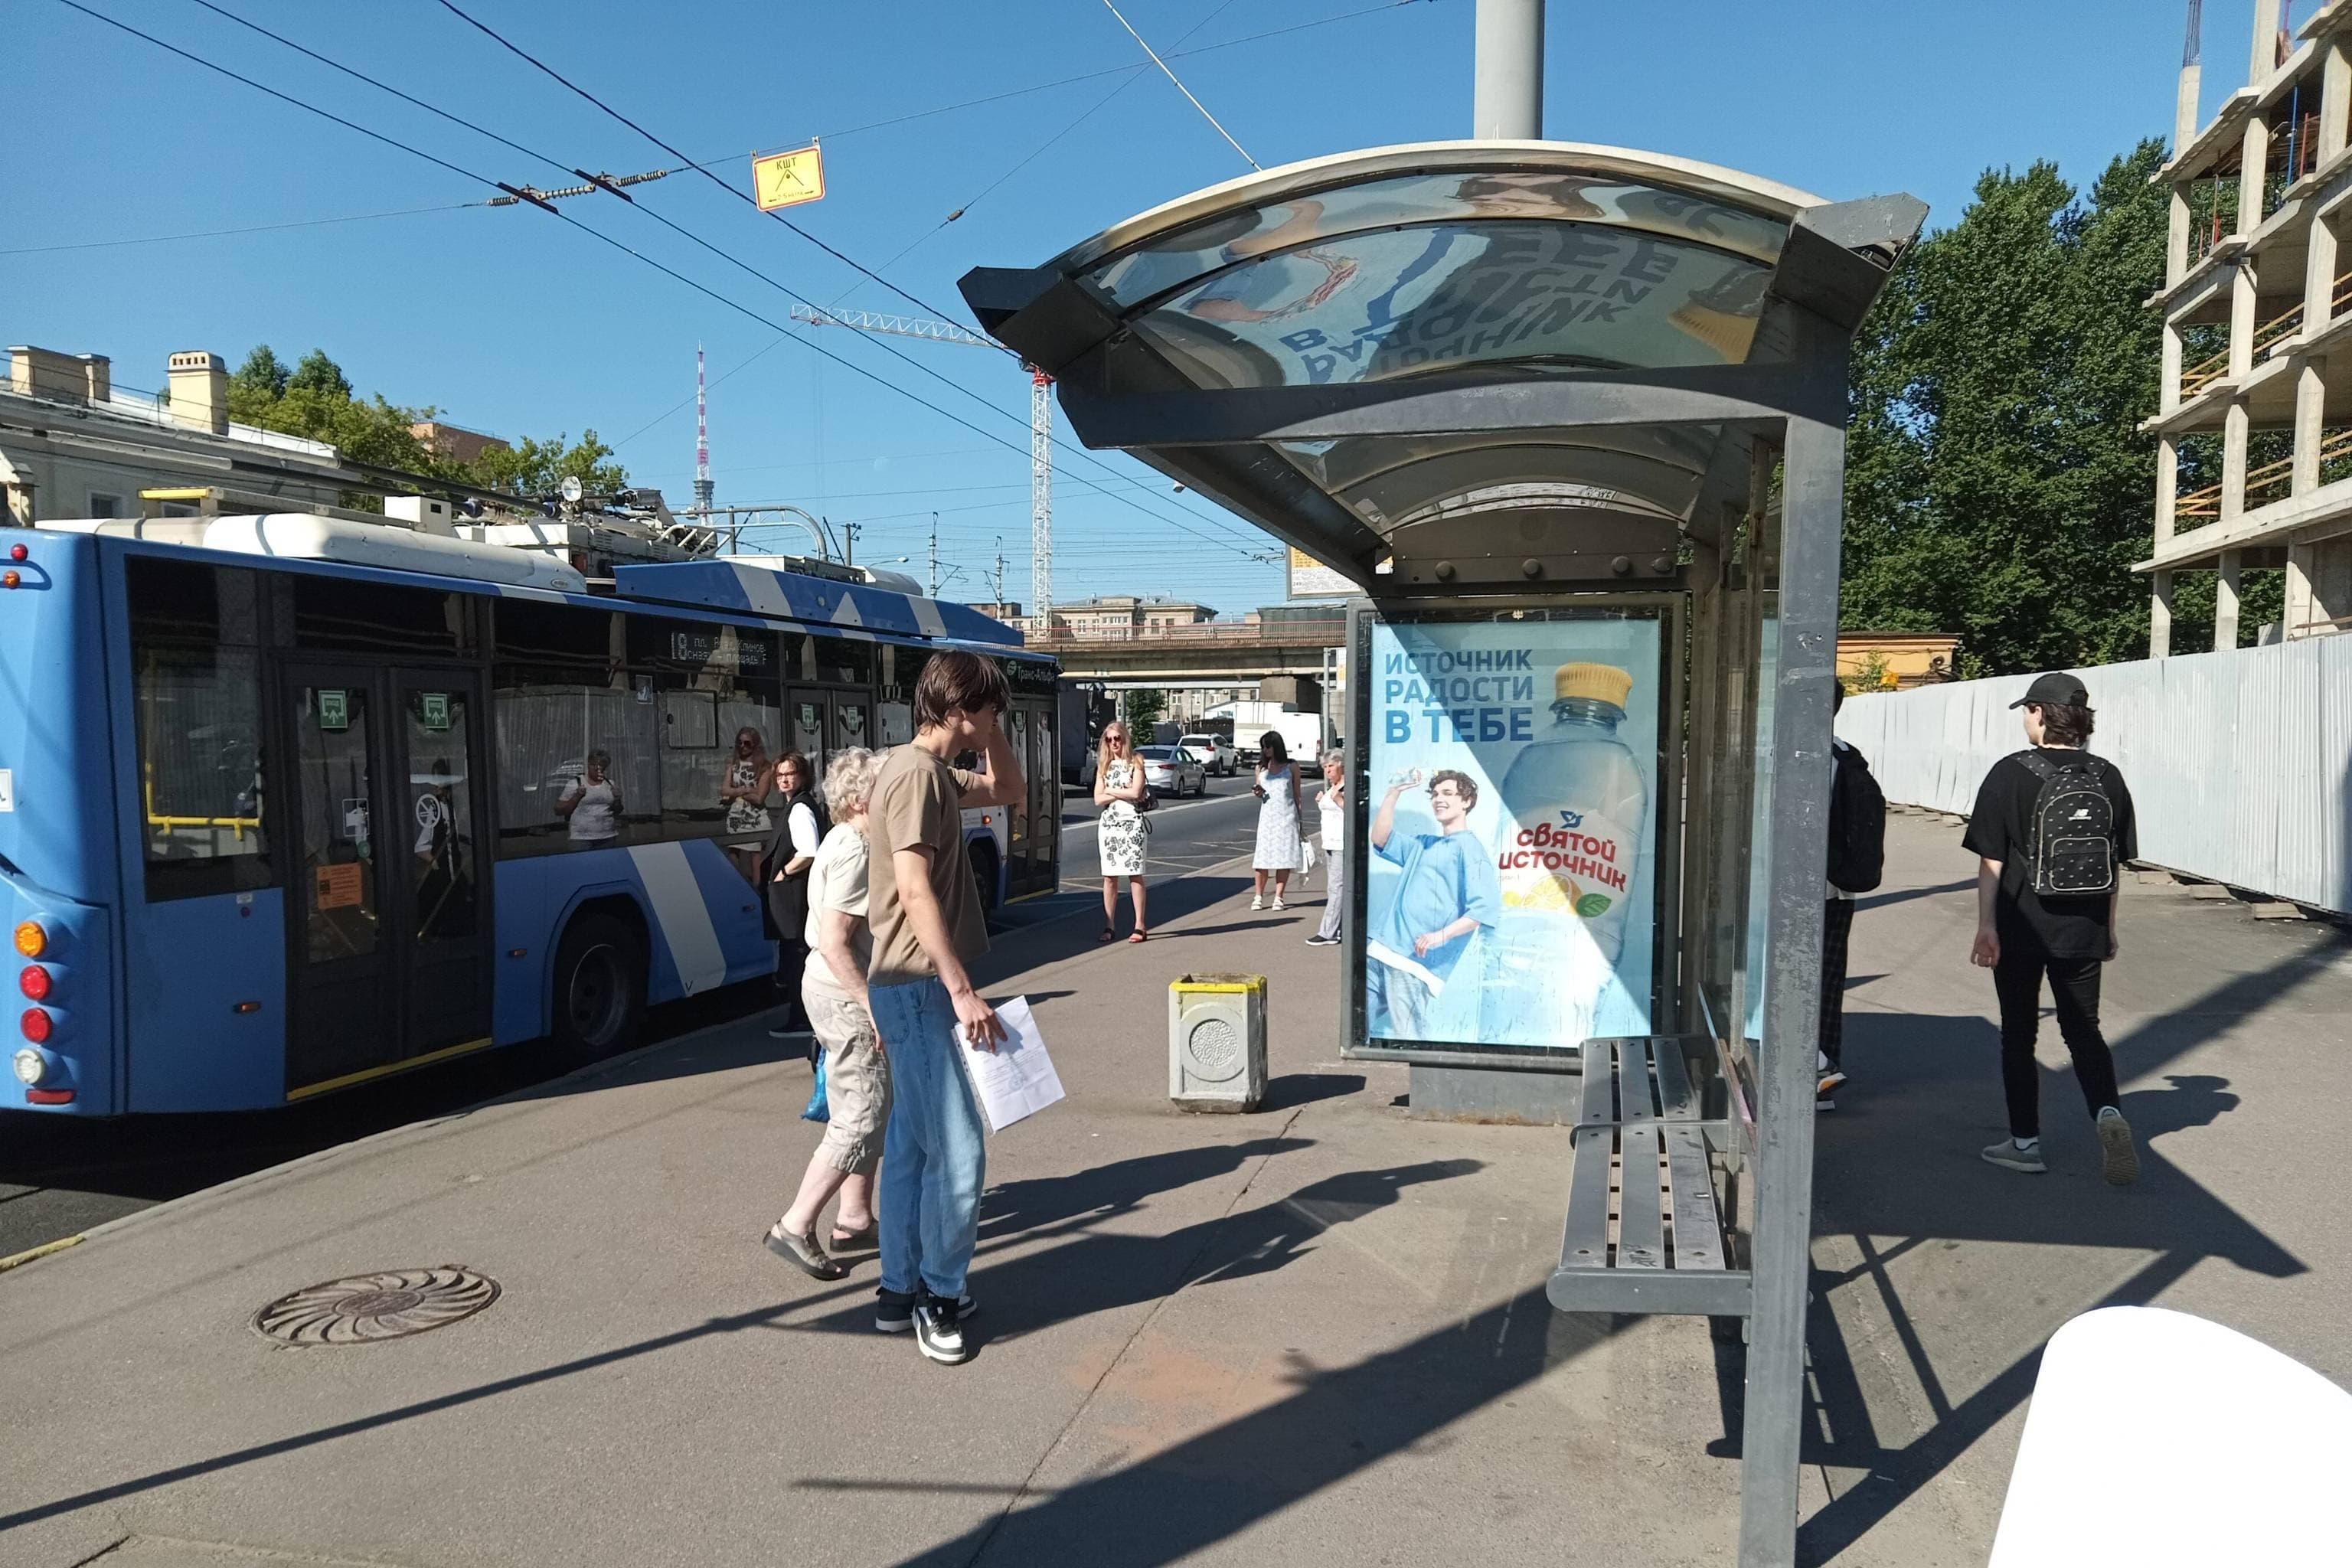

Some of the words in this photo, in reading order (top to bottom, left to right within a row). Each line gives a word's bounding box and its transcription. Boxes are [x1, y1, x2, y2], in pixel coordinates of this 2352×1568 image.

[776, 157, 797, 171] КШТ
[1385, 649, 1534, 675] ИСТОЧНИК
[1385, 676, 1533, 707] РАДОСТИ
[1385, 709, 1411, 743] В
[1422, 707, 1534, 743] ТЕБЕ
